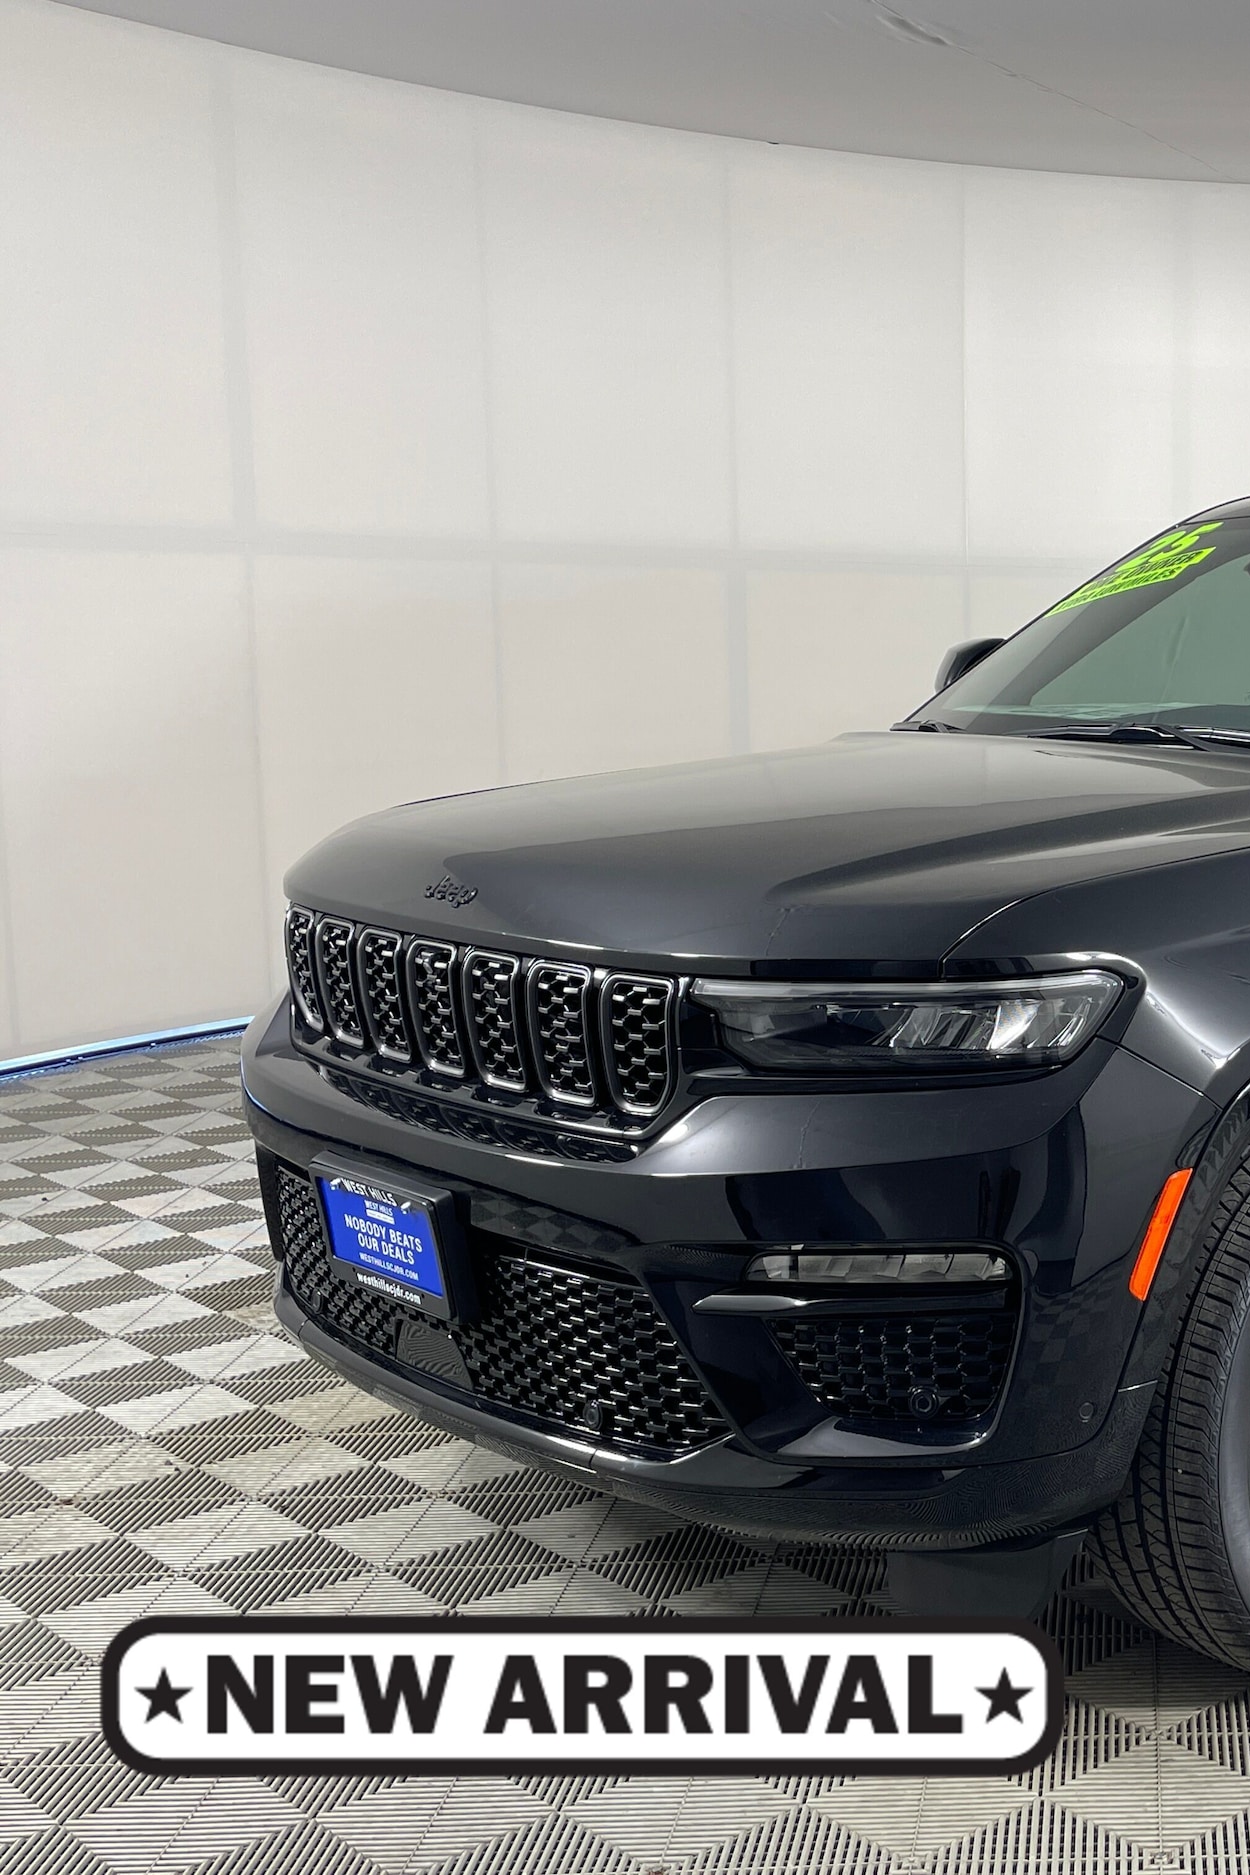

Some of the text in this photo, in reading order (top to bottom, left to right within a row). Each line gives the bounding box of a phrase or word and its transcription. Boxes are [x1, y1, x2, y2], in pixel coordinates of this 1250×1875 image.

[1114, 521, 1224, 573] 25
[424, 874, 479, 909] Jeep
[341, 1177, 398, 1207] WEST HILLS
[364, 1199, 379, 1211] WEST
[344, 1213, 387, 1240] NOBODY
[389, 1228, 423, 1253] BEATS
[357, 1234, 415, 1265] OUR DEALS
